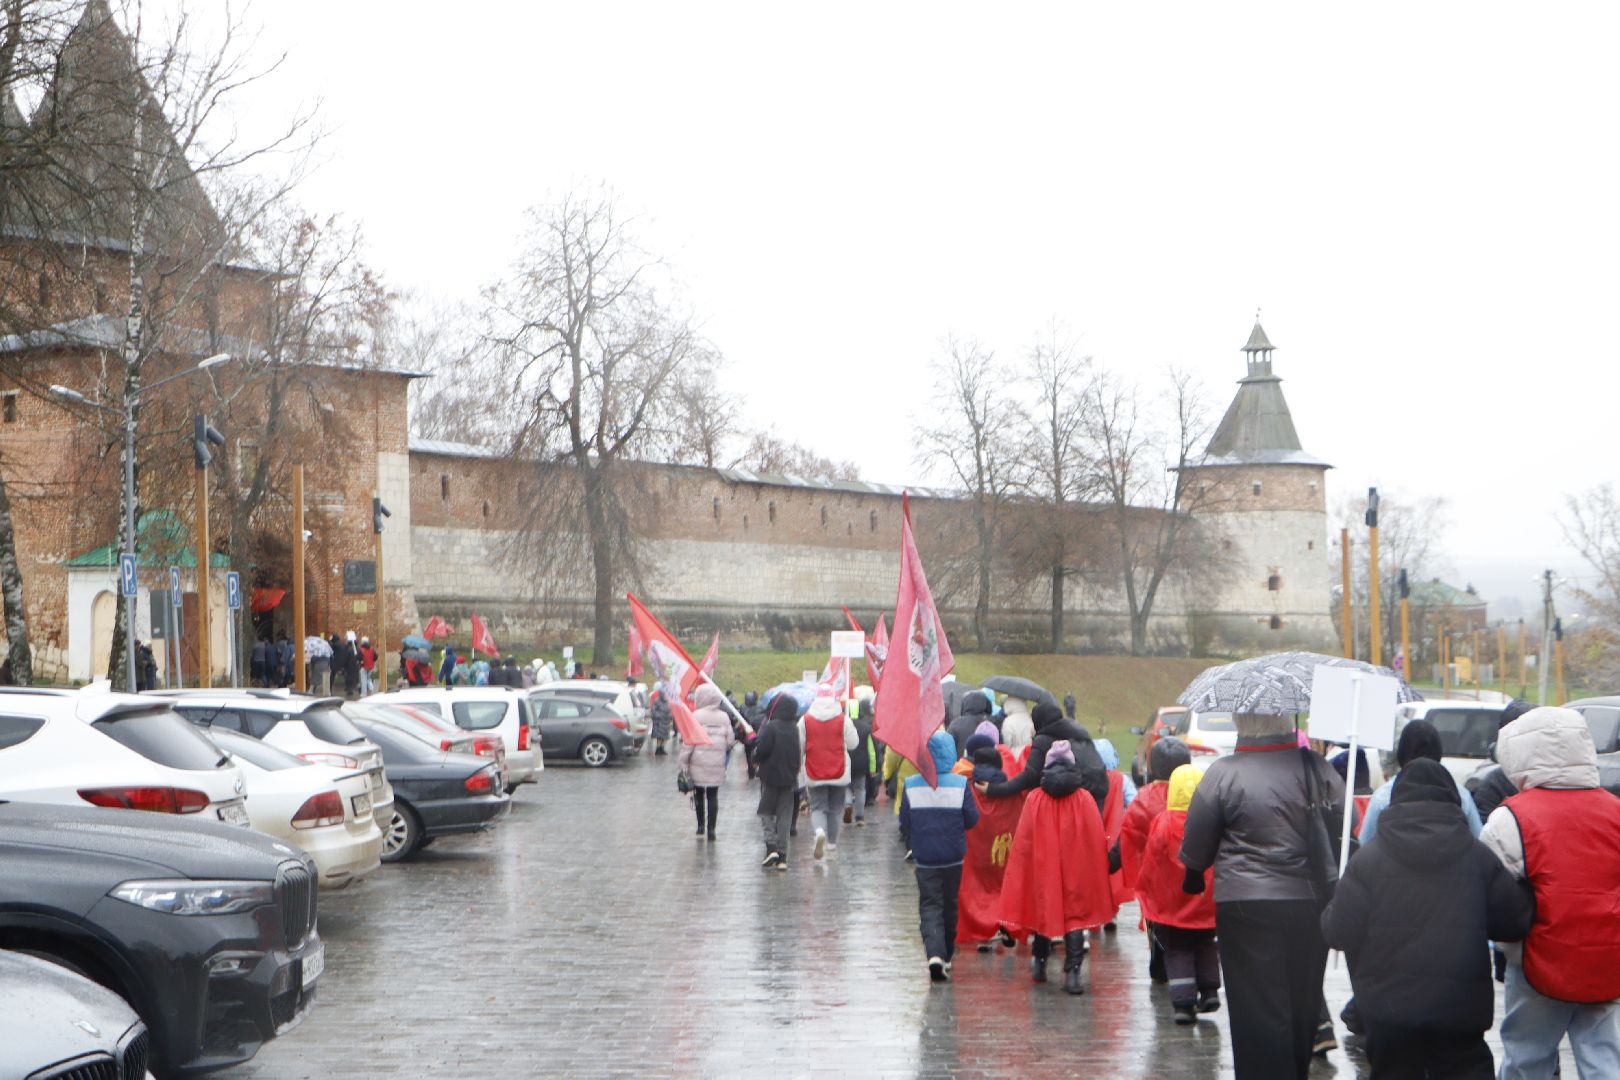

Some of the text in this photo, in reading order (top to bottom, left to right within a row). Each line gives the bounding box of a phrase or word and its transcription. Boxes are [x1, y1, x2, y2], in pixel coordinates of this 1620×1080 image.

[124, 559, 133, 592] P
[172, 571, 179, 602] P
[229, 576, 238, 605] P
